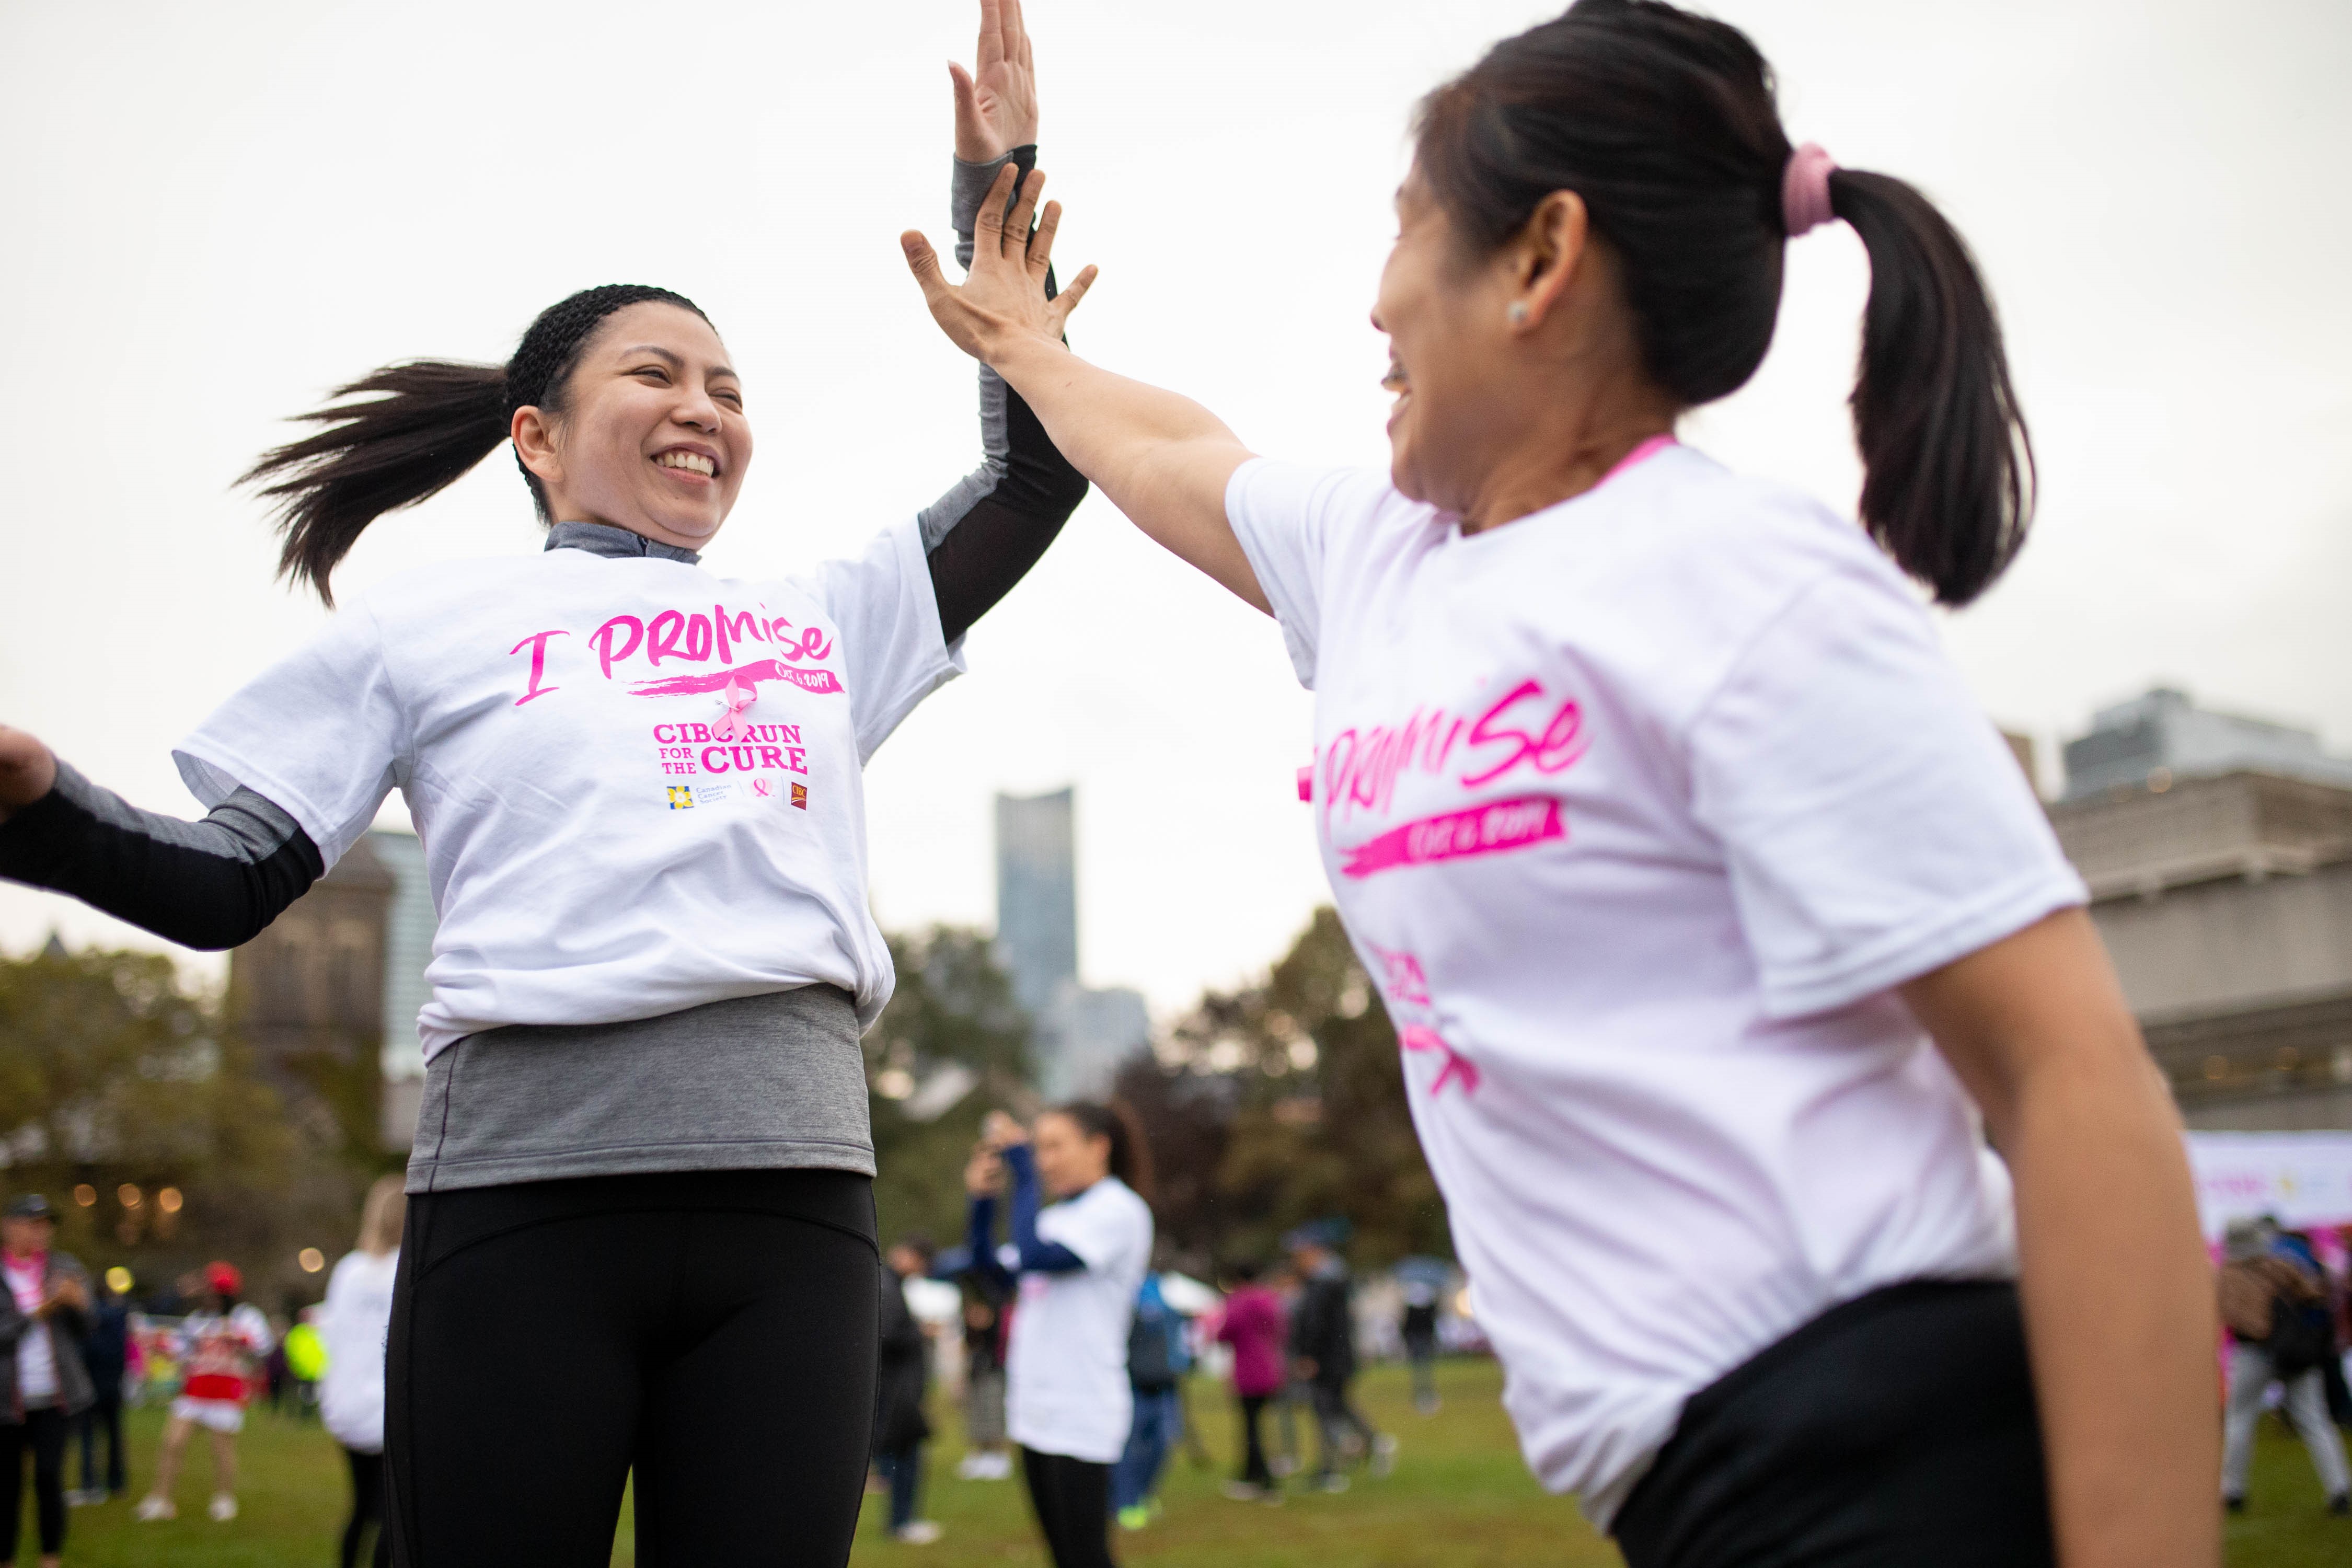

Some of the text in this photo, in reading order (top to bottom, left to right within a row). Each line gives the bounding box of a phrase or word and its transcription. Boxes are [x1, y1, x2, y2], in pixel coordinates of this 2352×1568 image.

[509, 630, 570, 707] I
[741, 724, 802, 744] RUN
[659, 747, 695, 759] FOR
[701, 745, 808, 776] CURE
[662, 762, 697, 775] THE
[696, 785, 732, 793] Canadian
[698, 790, 724, 799] Cancer
[792, 785, 806, 798] CIBC
